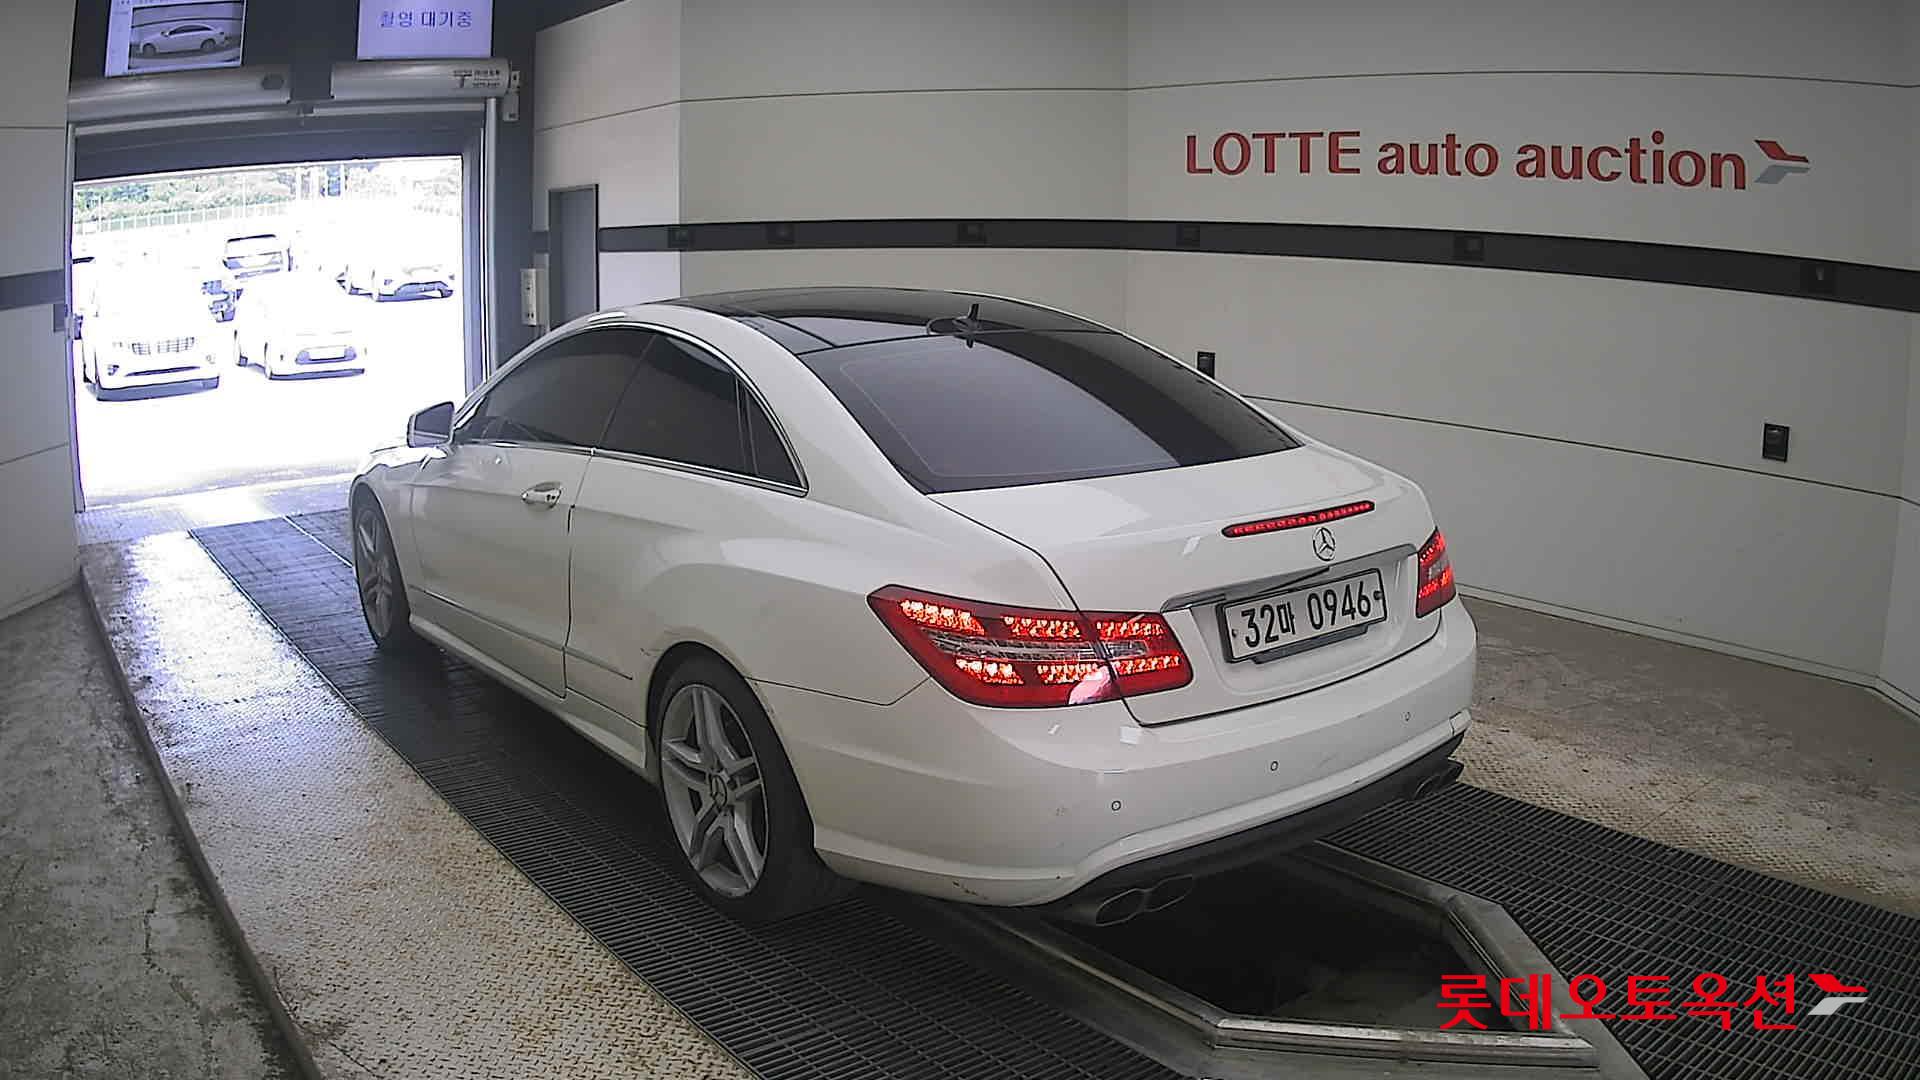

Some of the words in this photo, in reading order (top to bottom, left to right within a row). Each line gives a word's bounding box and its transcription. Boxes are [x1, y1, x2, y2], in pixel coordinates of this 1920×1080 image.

[421, 10, 472, 28] 대기중
[1185, 130, 1362, 175] LOTTE
[1377, 132, 1500, 178] auto
[1515, 130, 1747, 190] auction
[1241, 601, 1296, 648] 32마
[1307, 581, 1372, 630] 0946
